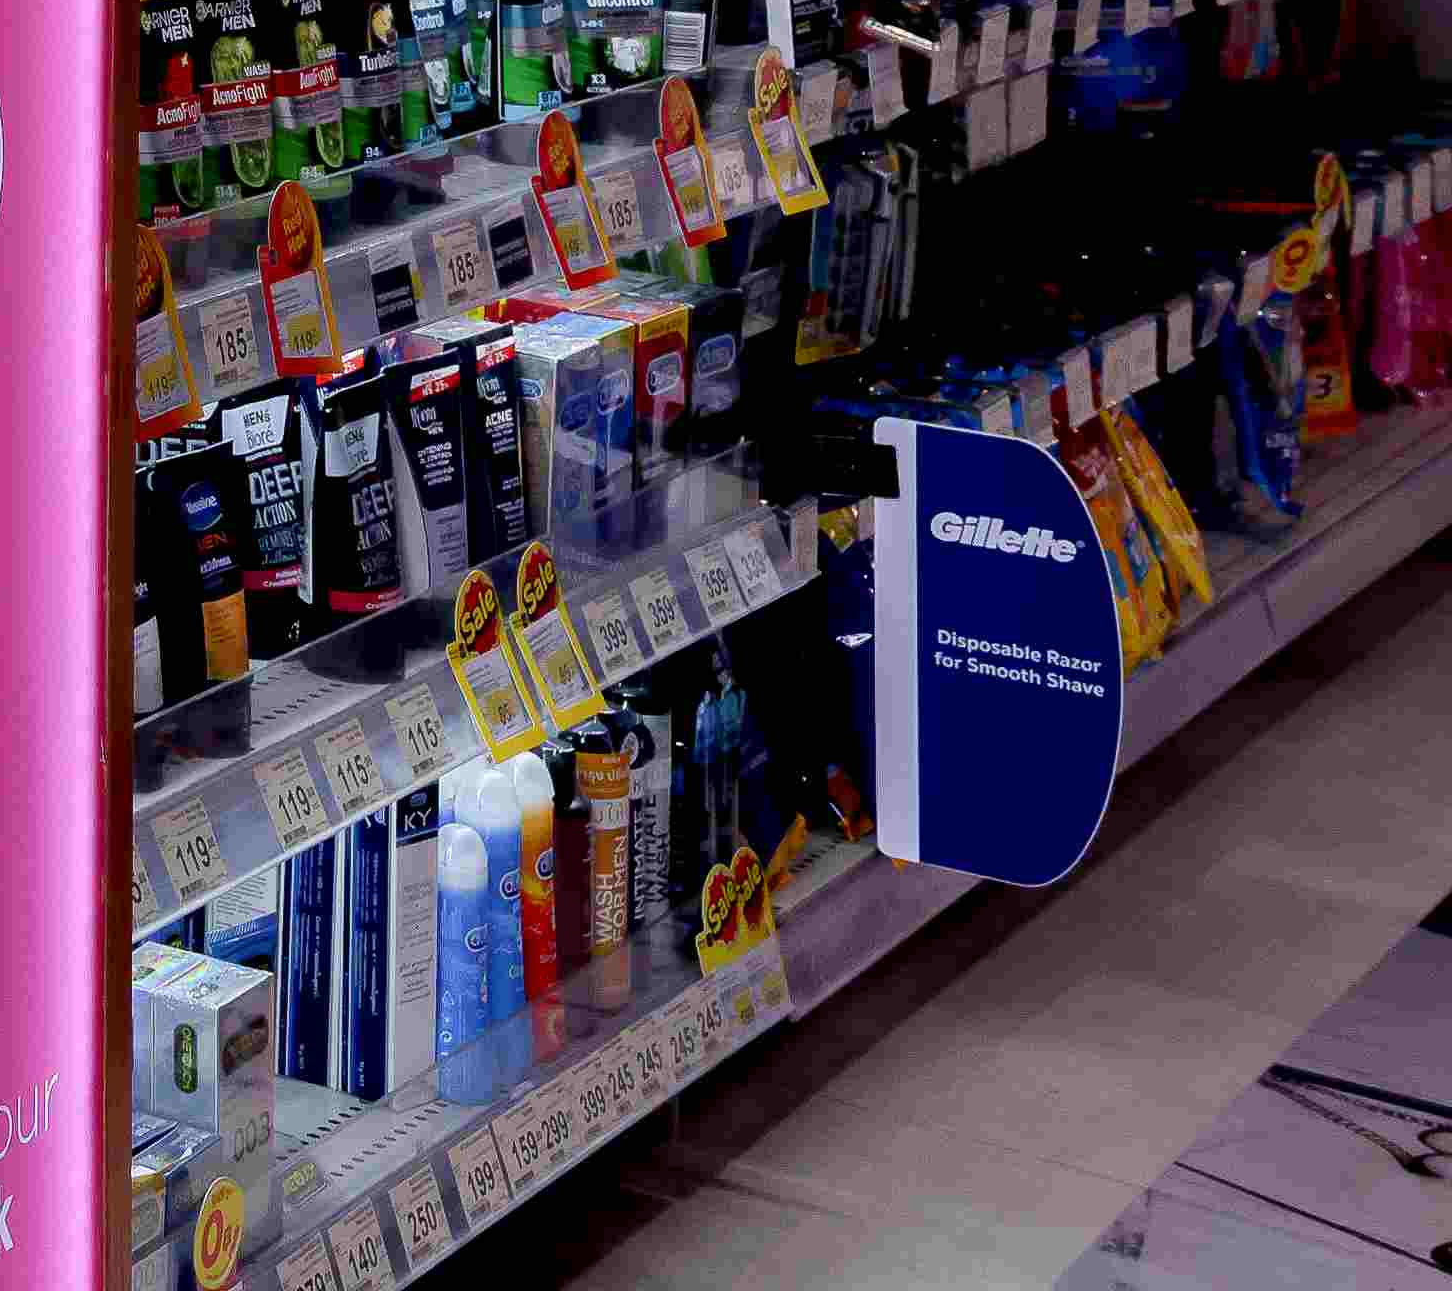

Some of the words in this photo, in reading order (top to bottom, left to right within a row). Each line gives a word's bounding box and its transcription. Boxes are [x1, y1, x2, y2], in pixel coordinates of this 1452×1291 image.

[930, 511, 1078, 563] Gillette
[934, 651, 963, 671] for
[967, 657, 1042, 687] Smooth
[1046, 672, 1105, 698] Shave
[937, 628, 1042, 665] Disposable
[1046, 649, 1102, 674] Razor
